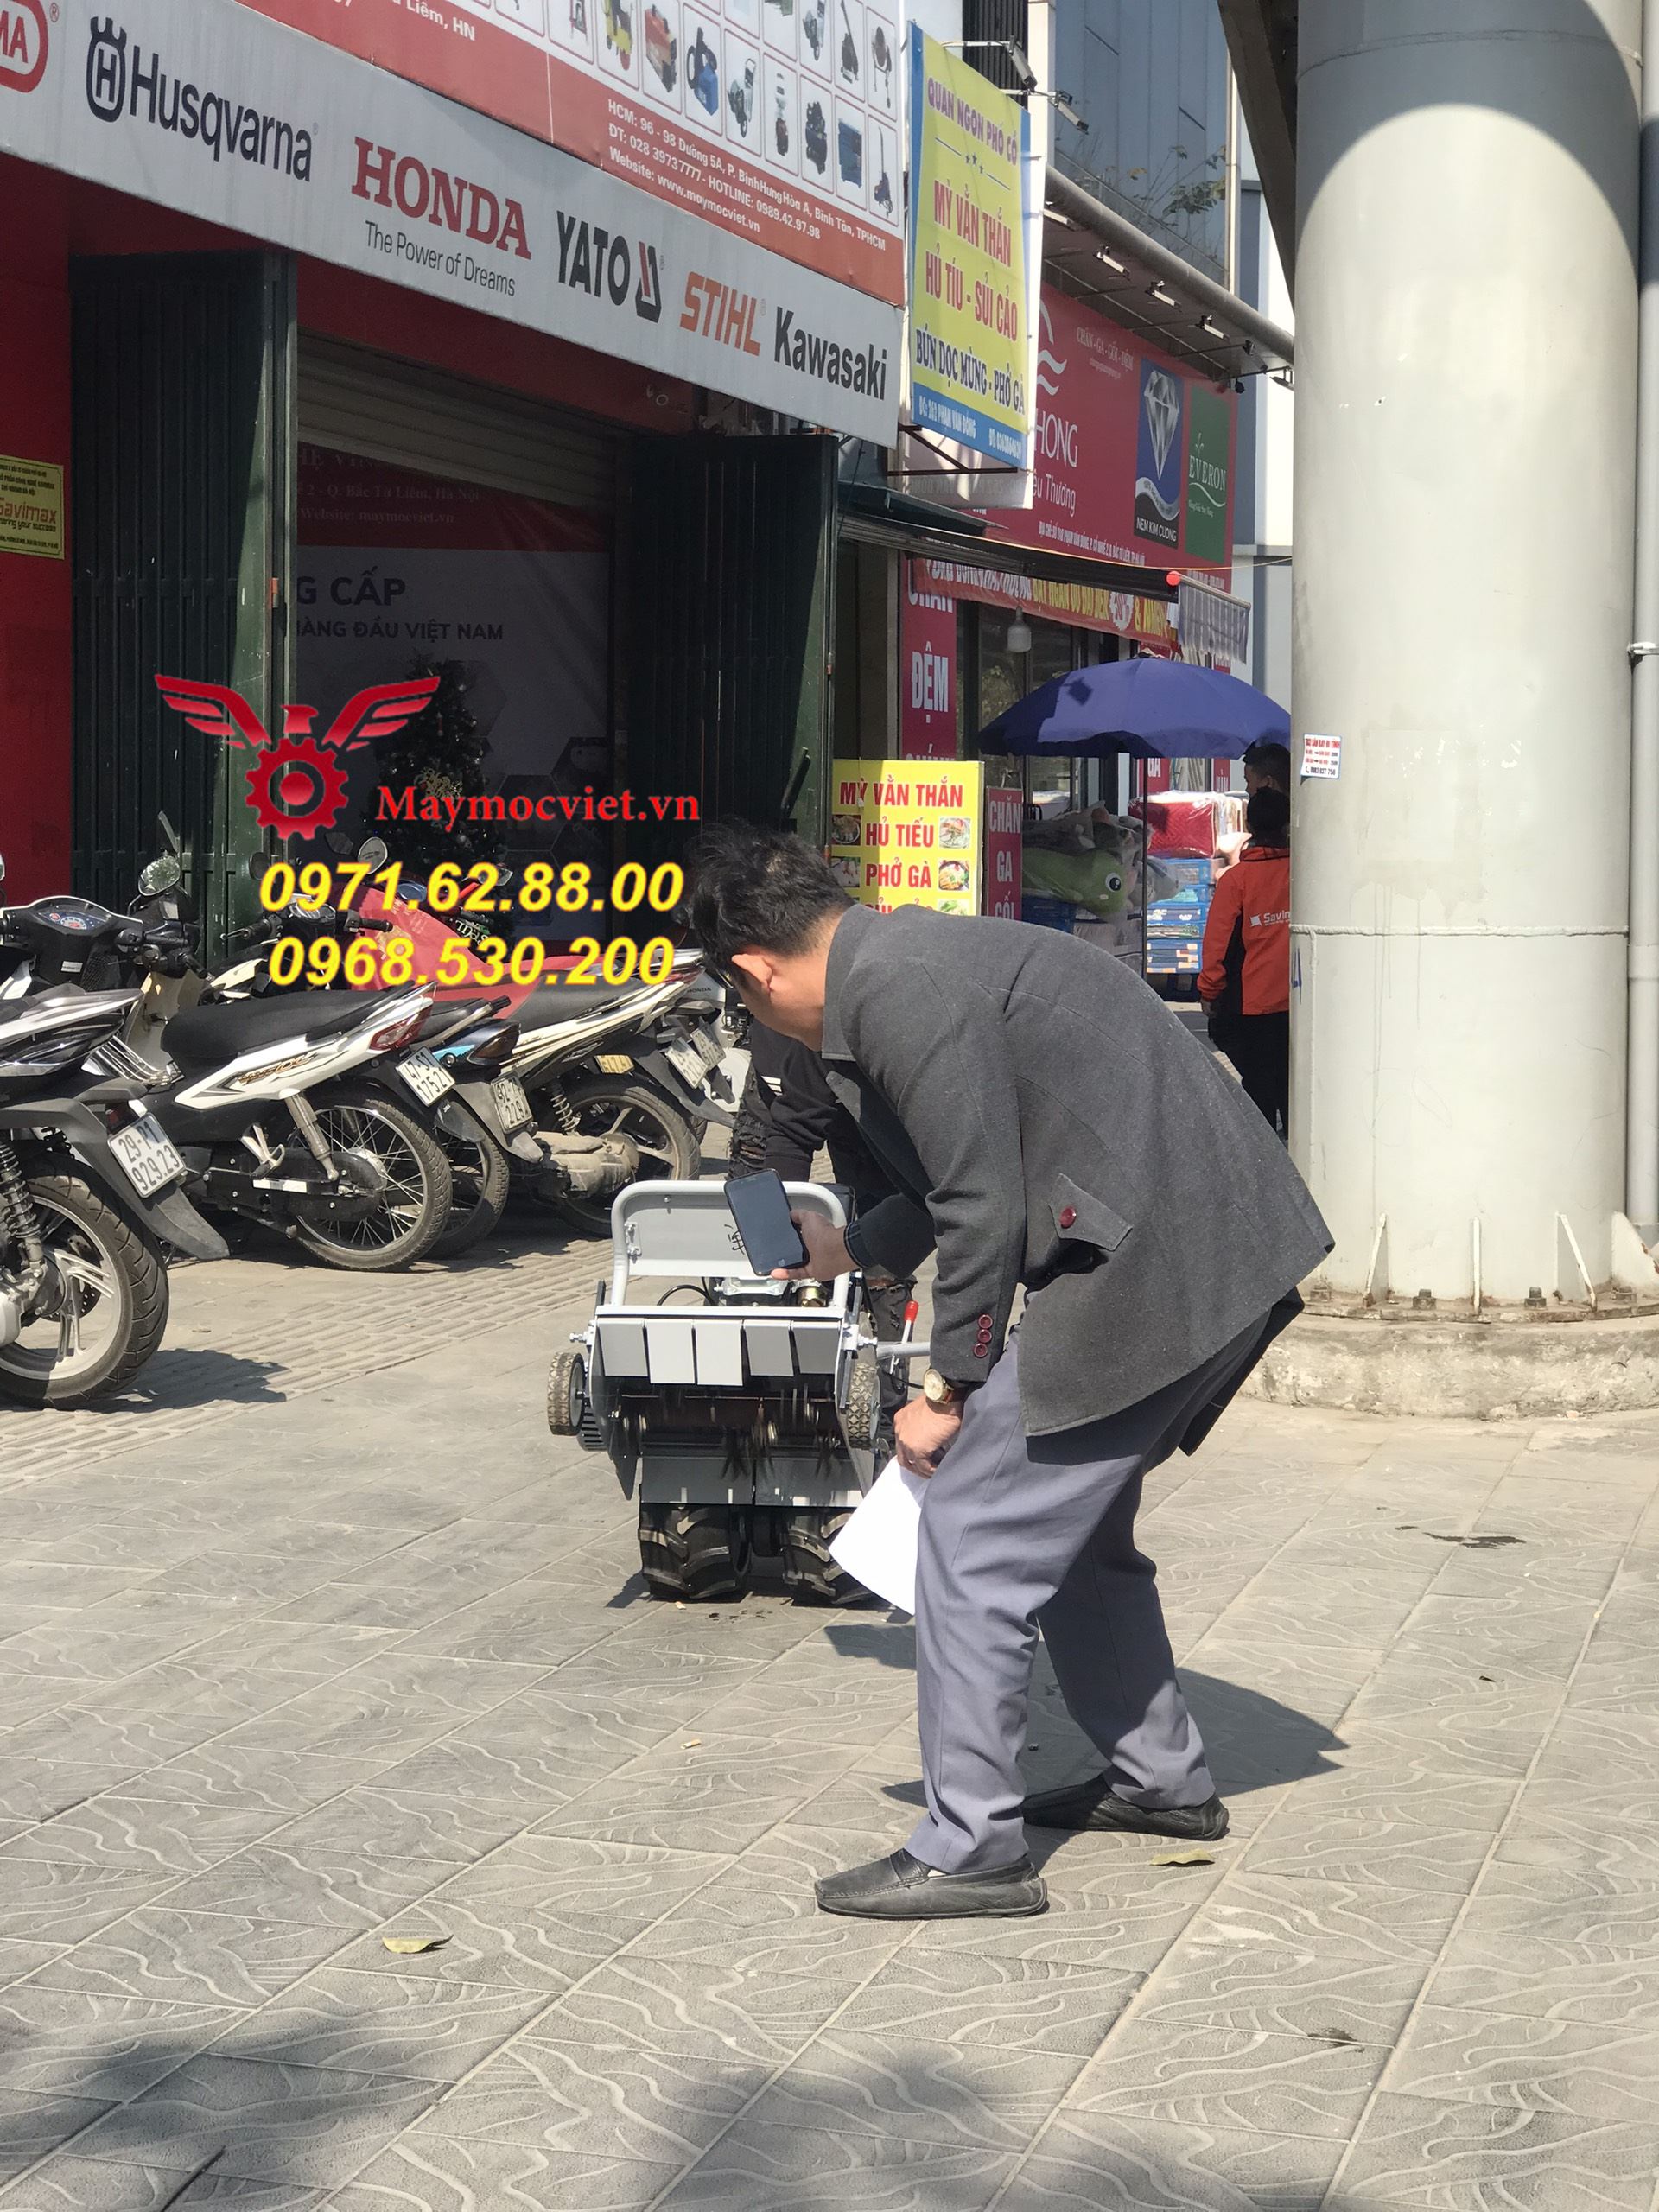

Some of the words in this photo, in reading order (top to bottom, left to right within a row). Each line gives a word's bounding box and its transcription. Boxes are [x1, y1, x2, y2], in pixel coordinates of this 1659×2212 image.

[453, 16, 475, 41] HN
[130, 45, 312, 181] Husqvarna
[957, 98, 983, 142] NGON
[608, 99, 637, 127] HCM:
[640, 118, 654, 136] 96
[663, 130, 676, 147] 98
[710, 152, 726, 174] 5A,
[728, 162, 736, 178] P.
[803, 201, 813, 217] A,
[856, 226, 886, 251] TPHCM
[609, 122, 627, 144] ĐT:
[629, 135, 650, 156] 028
[709, 175, 754, 208] HOTLINE:
[756, 199, 821, 239] 0989.42.97.98
[610, 145, 655, 181] Website:
[658, 174, 760, 232] www.maymocviet.vn
[352, 136, 531, 260] HONDA
[365, 220, 393, 253] The
[396, 232, 443, 270] Power
[445, 252, 461, 276] of
[464, 257, 515, 296] Dreams
[556, 210, 630, 306] YATO
[679, 271, 760, 356] STIHL
[926, 243, 942, 299] HỦ
[945, 257, 963, 311] TÍU
[975, 272, 993, 328] SỦI
[996, 285, 1017, 342] CẢO
[774, 306, 887, 401] Kawasaki
[916, 323, 937, 369] BÚN
[939, 340, 958, 387] DỌC
[960, 346, 987, 395] MÙNG
[994, 362, 1011, 407] PHỞ
[1046, 474, 1076, 517] Thương
[1189, 454, 1226, 492] EVERON
[330, 566, 406, 607] CẤP
[353, 615, 398, 639] ĐẦU
[405, 618, 451, 643] VIỆT
[457, 623, 503, 641] NAM
[912, 640, 949, 723] ĐỆM
[840, 778, 868, 804] MỲ
[874, 774, 908, 806] VẰN
[916, 776, 963, 808] THẮN
[866, 816, 890, 847] HỦ
[895, 817, 934, 848] TIẾU
[988, 796, 1021, 834] CHĂN
[866, 857, 902, 887] PHỞ
[908, 861, 931, 887] GÀ
[996, 851, 1013, 882] GA
[416, 1067, 452, 1102] 175.21
[118, 1121, 160, 1164] 29-P1
[131, 1145, 180, 1191] 929.23
